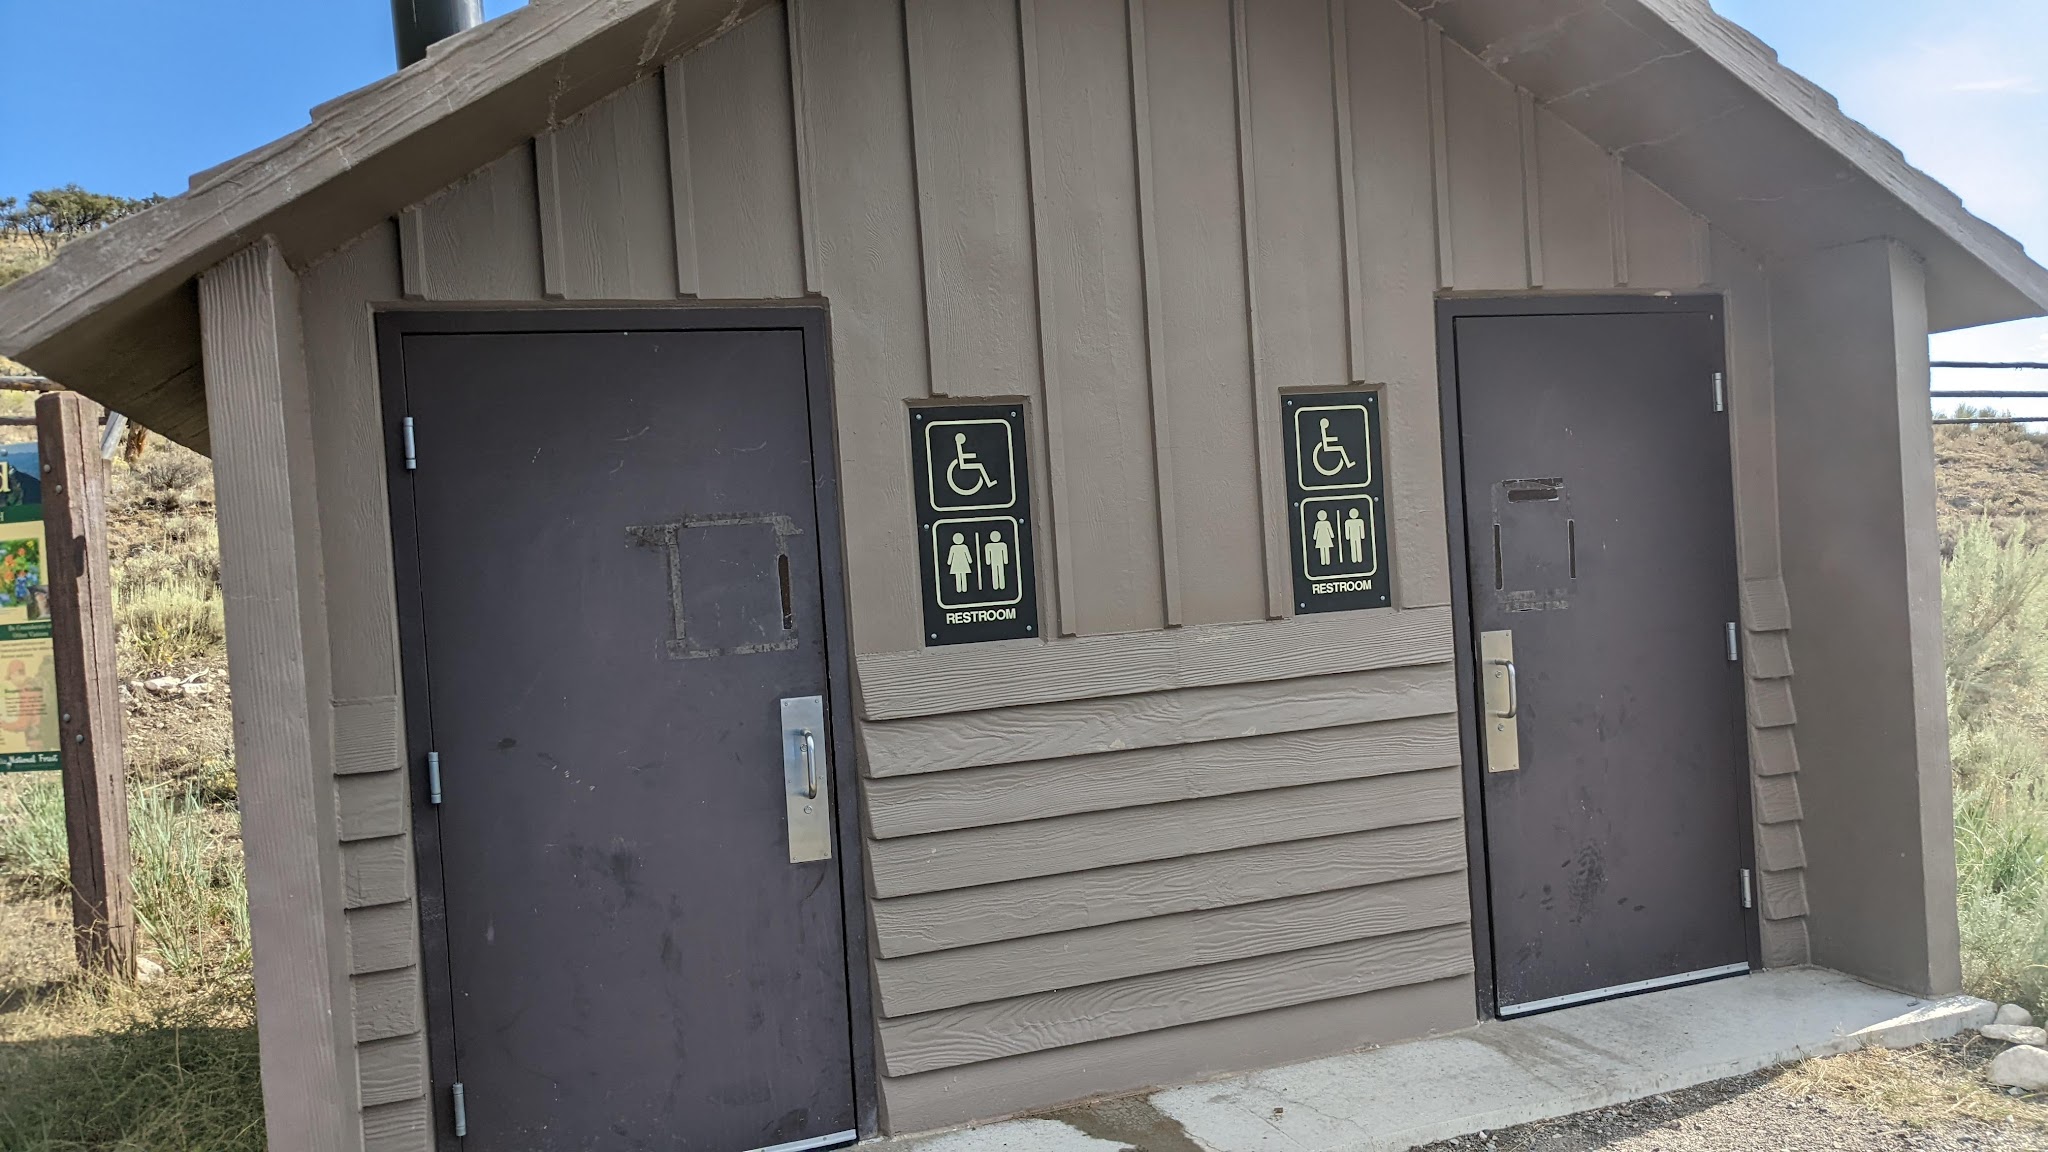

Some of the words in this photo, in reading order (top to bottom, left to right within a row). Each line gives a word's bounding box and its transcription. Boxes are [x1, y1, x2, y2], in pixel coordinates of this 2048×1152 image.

[1312, 580, 1372, 594] RESTROOM
[946, 608, 1016, 624] RESTROOM
[9, 754, 36, 764] National
[38, 753, 58, 763] Forest
